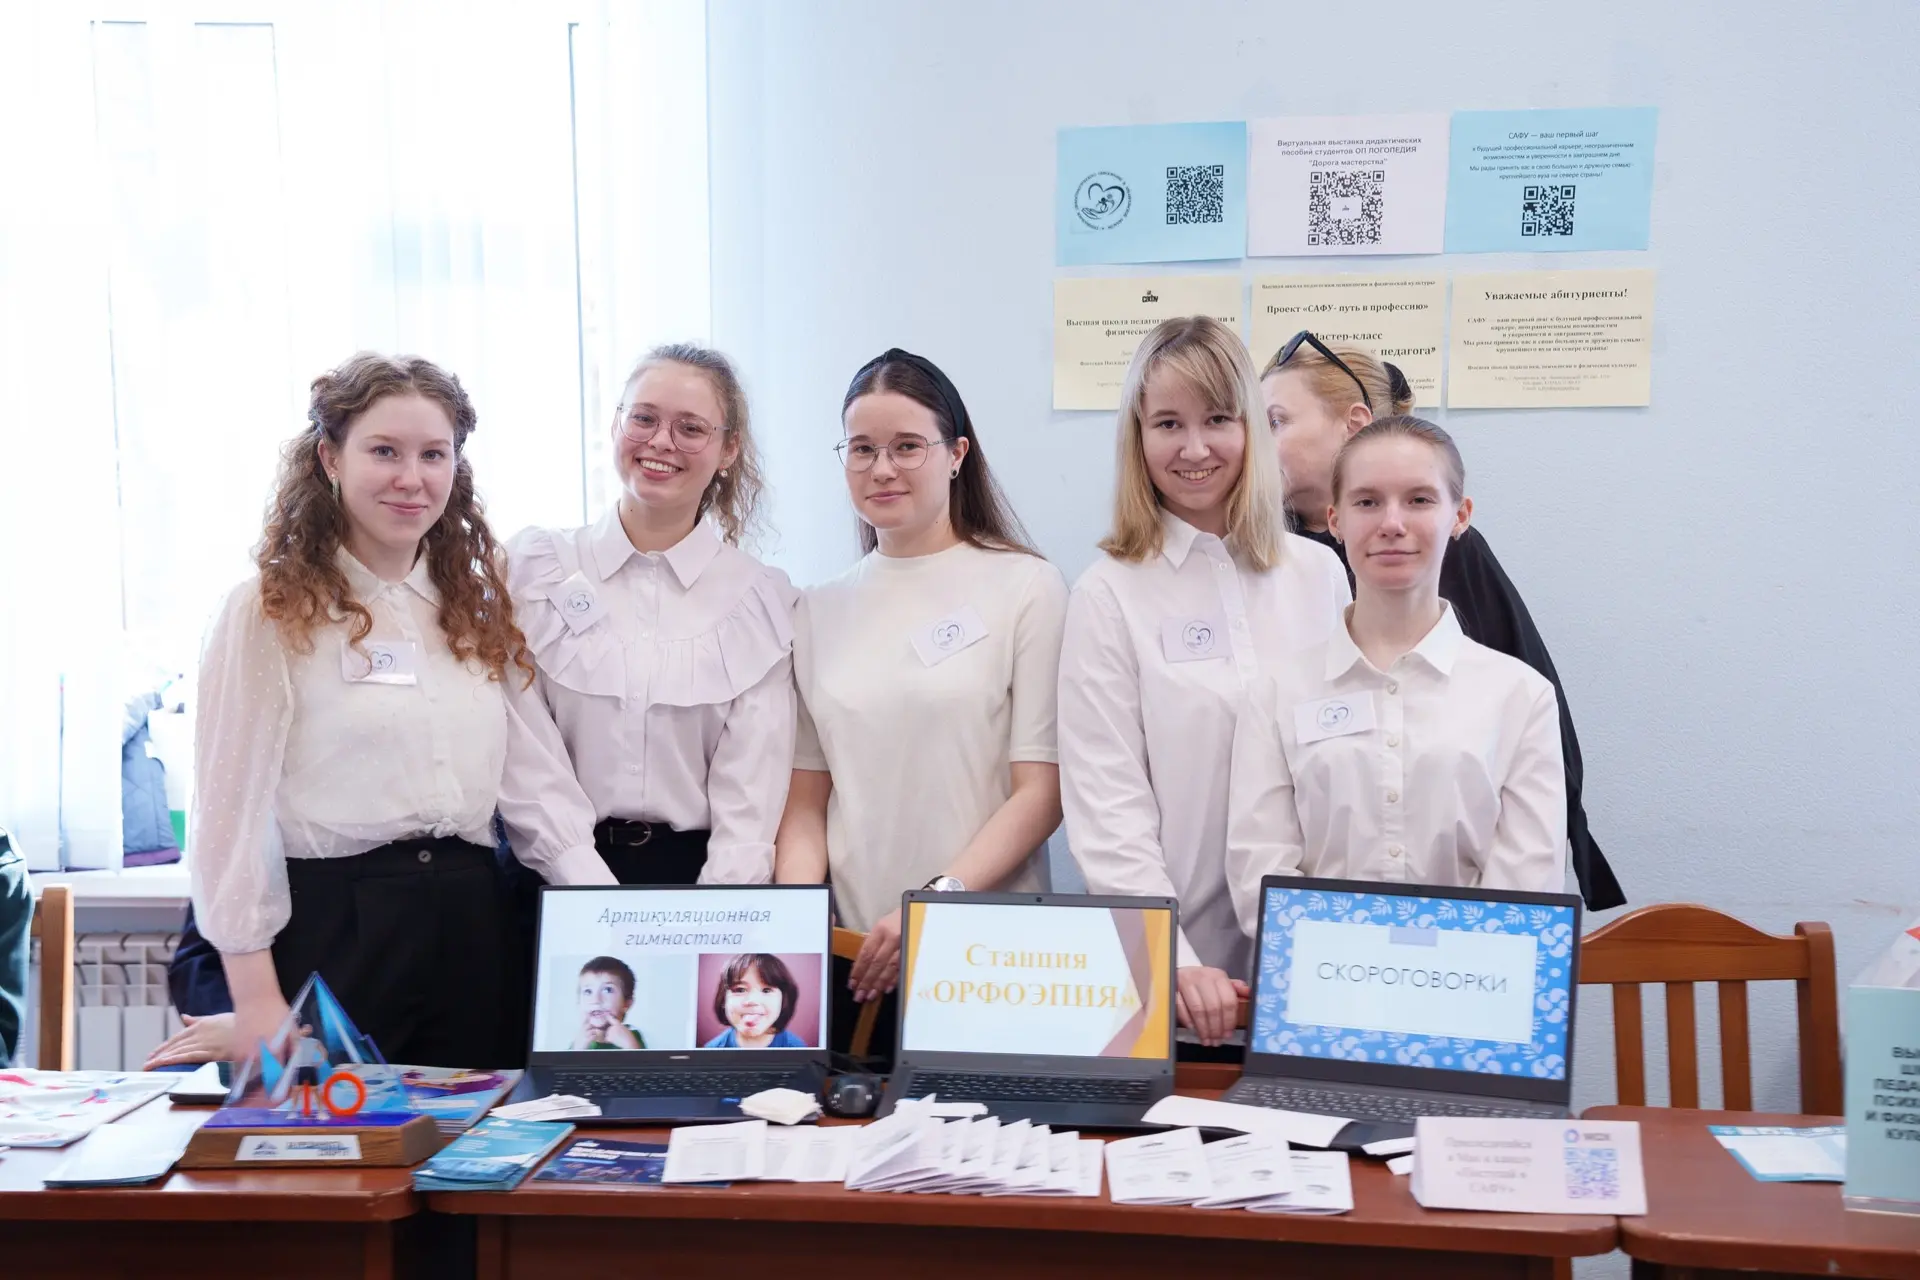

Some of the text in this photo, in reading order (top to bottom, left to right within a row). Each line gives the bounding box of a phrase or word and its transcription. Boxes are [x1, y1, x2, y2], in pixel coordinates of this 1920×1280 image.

[1484, 288, 1628, 300] Уважаемые абитуриенты!
[1267, 305, 1300, 314] Проект
[1370, 303, 1428, 312] профессию»
[597, 907, 772, 926] Артикуляционная
[626, 932, 743, 946] гимнастика
[966, 944, 1088, 970] Станция
[1318, 962, 1508, 994] СКОРОГОВОРКИ
[917, 980, 1136, 1008] «ОРФОЭПИЯ»
